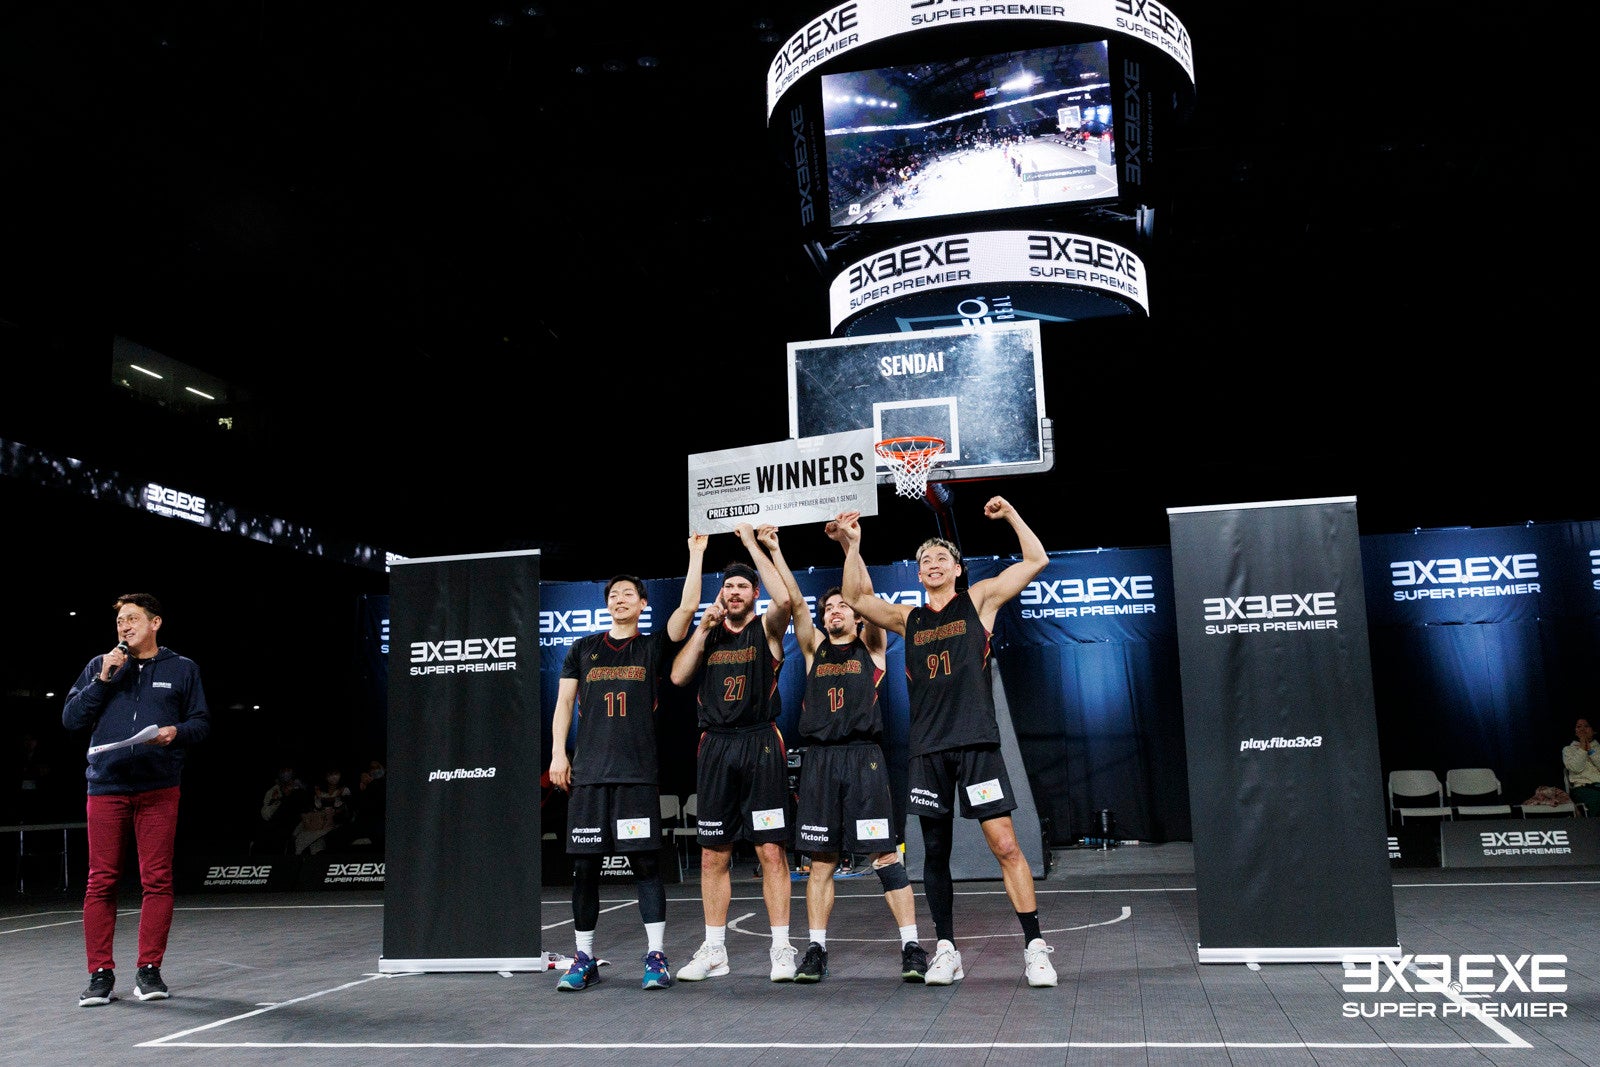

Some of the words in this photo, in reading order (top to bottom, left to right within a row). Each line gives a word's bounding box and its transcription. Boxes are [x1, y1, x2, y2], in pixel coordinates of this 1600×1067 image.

[911, 7, 976, 25] SUPER
[980, 4, 1065, 16] PREMIER
[1116, 17, 1159, 40] SUPER
[801, 33, 859, 71] PREMIER
[850, 285, 890, 310] SUPER
[893, 269, 971, 293] PREMIER
[1029, 266, 1087, 281] SUPER
[1090, 272, 1139, 297] PREMIER
[881, 352, 944, 377] SENDAI
[756, 452, 865, 494] WINNERS
[697, 489, 720, 498] SUPER
[720, 485, 751, 494] PREMIER
[708, 507, 729, 519] PRIZE
[1393, 588, 1455, 601] SUPER
[1458, 583, 1541, 598] PREMIER
[539, 606, 653, 632] 3X3.EE
[1021, 606, 1078, 619] SUPER
[1080, 603, 1156, 617] PREMIER
[1205, 622, 1261, 635] SUPER
[1262, 619, 1338, 632] PREMIER
[410, 664, 455, 676] SUPER
[456, 661, 517, 673] PREMIER
[927, 650, 951, 679] 91
[723, 675, 747, 702] 27
[604, 692, 627, 717] 11
[1240, 735, 1322, 751] play.fiba3x3
[428, 767, 497, 782] play.fiba3x3
[910, 795, 939, 808] Victoria
[571, 835, 602, 844] Victoria
[800, 832, 829, 842] Victoria
[1521, 847, 1571, 855] PREMIER
